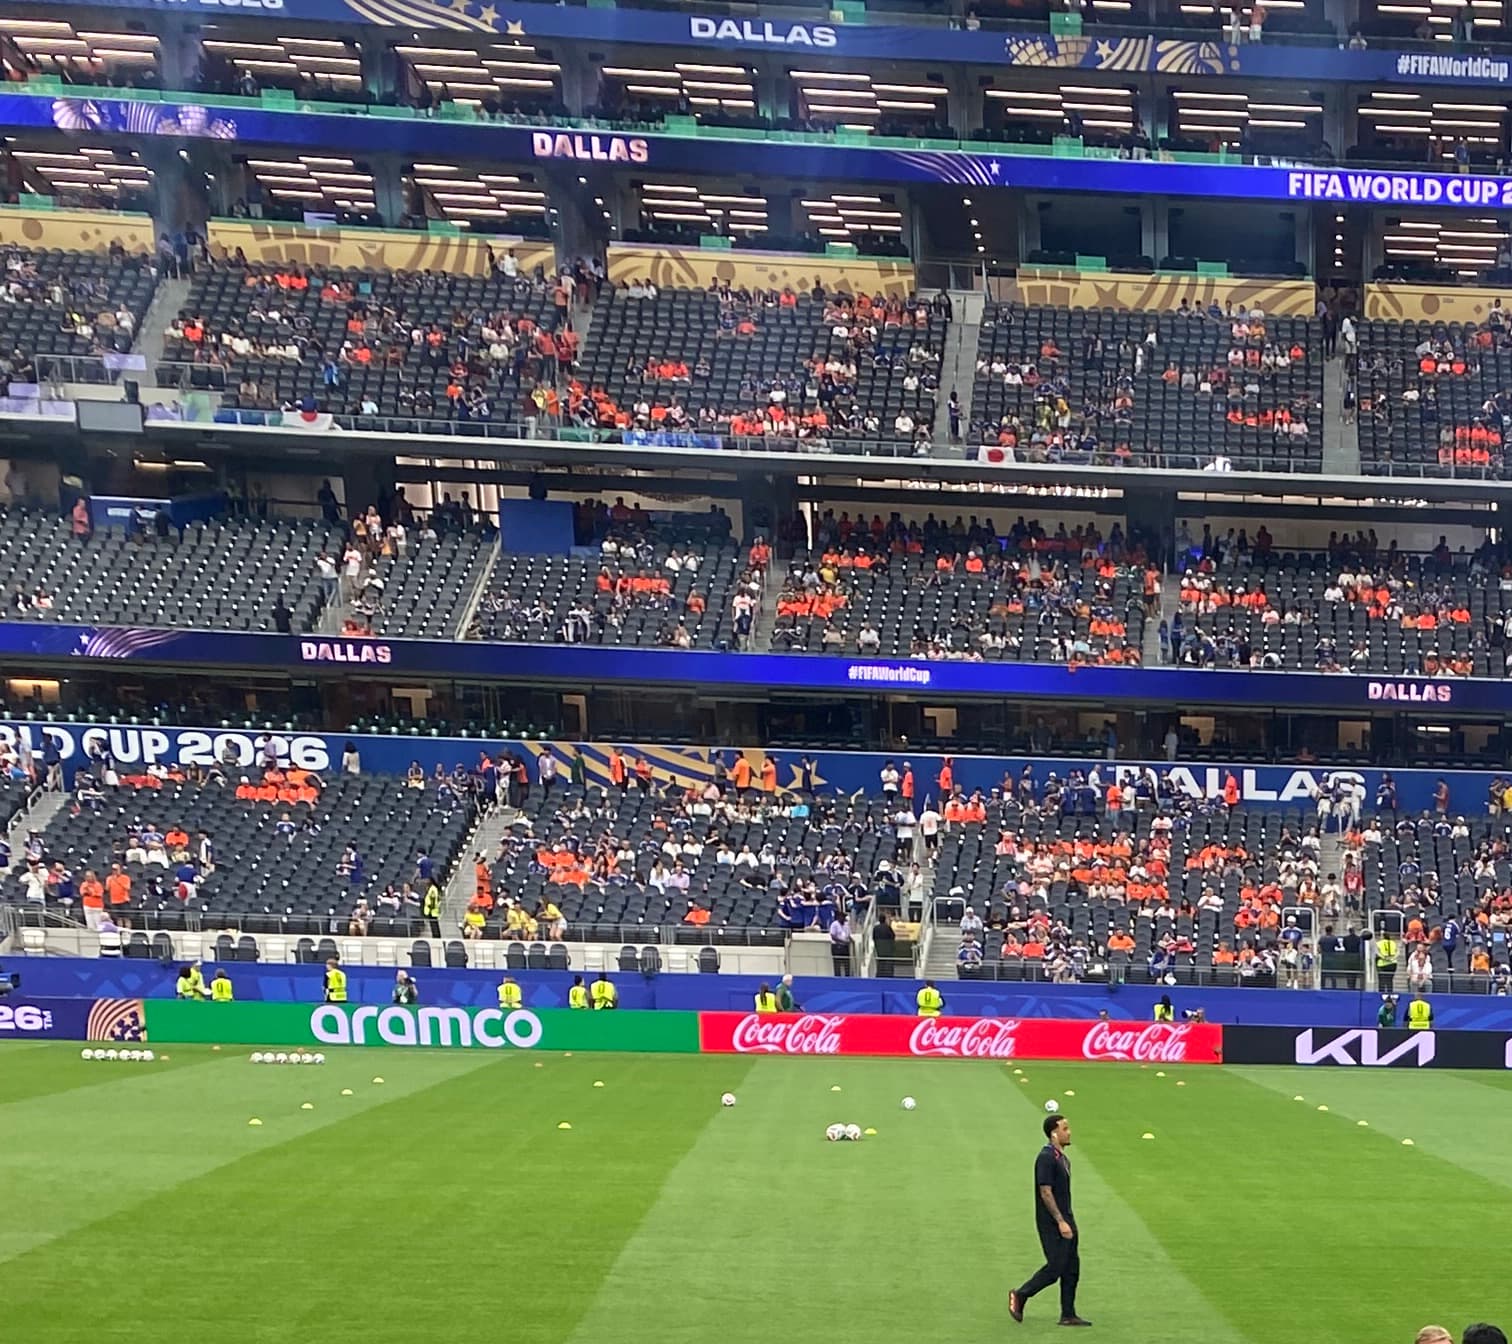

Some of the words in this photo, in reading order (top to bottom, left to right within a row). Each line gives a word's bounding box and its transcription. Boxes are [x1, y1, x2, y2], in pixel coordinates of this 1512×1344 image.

[690, 16, 836, 47] DALLAS
[1397, 54, 1508, 80] #FIFAWorldCup
[532, 132, 648, 163] DALLAS
[1289, 173, 1342, 199] FIFA
[1347, 176, 1441, 202] WORLD
[1446, 179, 1498, 205] CUP
[302, 643, 391, 665] DALLAS
[848, 666, 930, 683] #FIFAWorldCup
[1368, 682, 1451, 702] DALLAS
[0, 725, 74, 759] RLD
[178, 732, 329, 771] 2026
[0, 1005, 43, 1030] 26
[310, 1005, 542, 1048] aramco
[733, 1014, 846, 1053] Coca-Cola
[909, 1018, 1020, 1057] Coca-Cola
[1082, 1022, 1193, 1061] Coca-Cola
[1295, 1028, 1435, 1066] KIA
